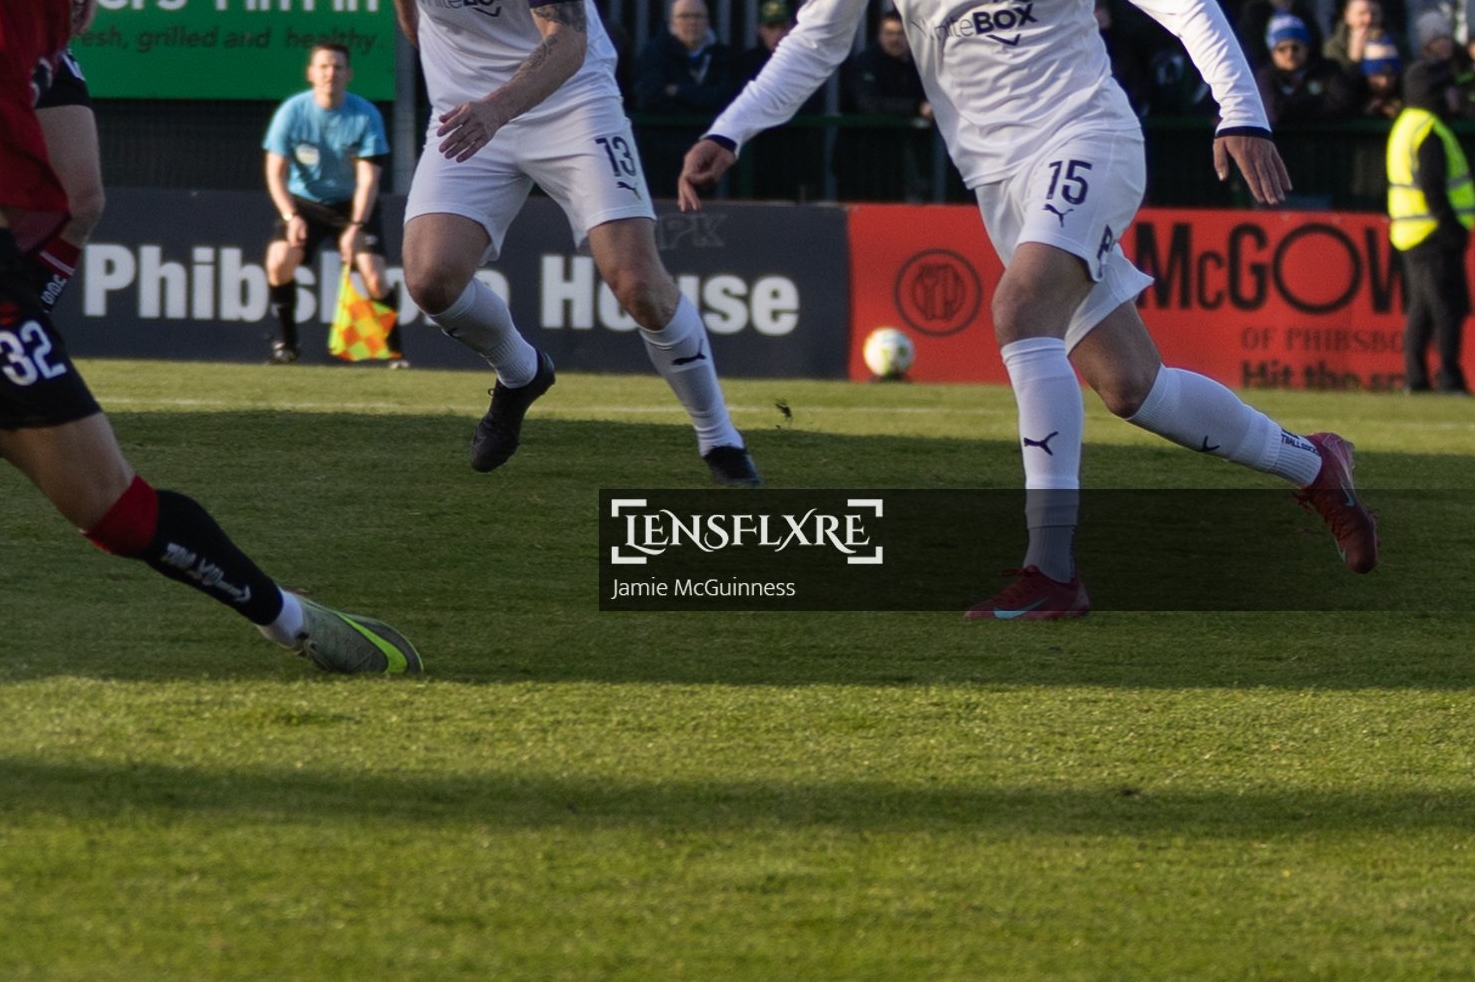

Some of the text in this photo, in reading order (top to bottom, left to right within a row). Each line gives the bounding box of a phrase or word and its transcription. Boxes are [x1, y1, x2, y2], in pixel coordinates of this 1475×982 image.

[595, 136, 637, 178] 13
[1045, 159, 1092, 206] 15
[1135, 222, 1408, 316] McGOW
[1241, 327, 1272, 351] OF
